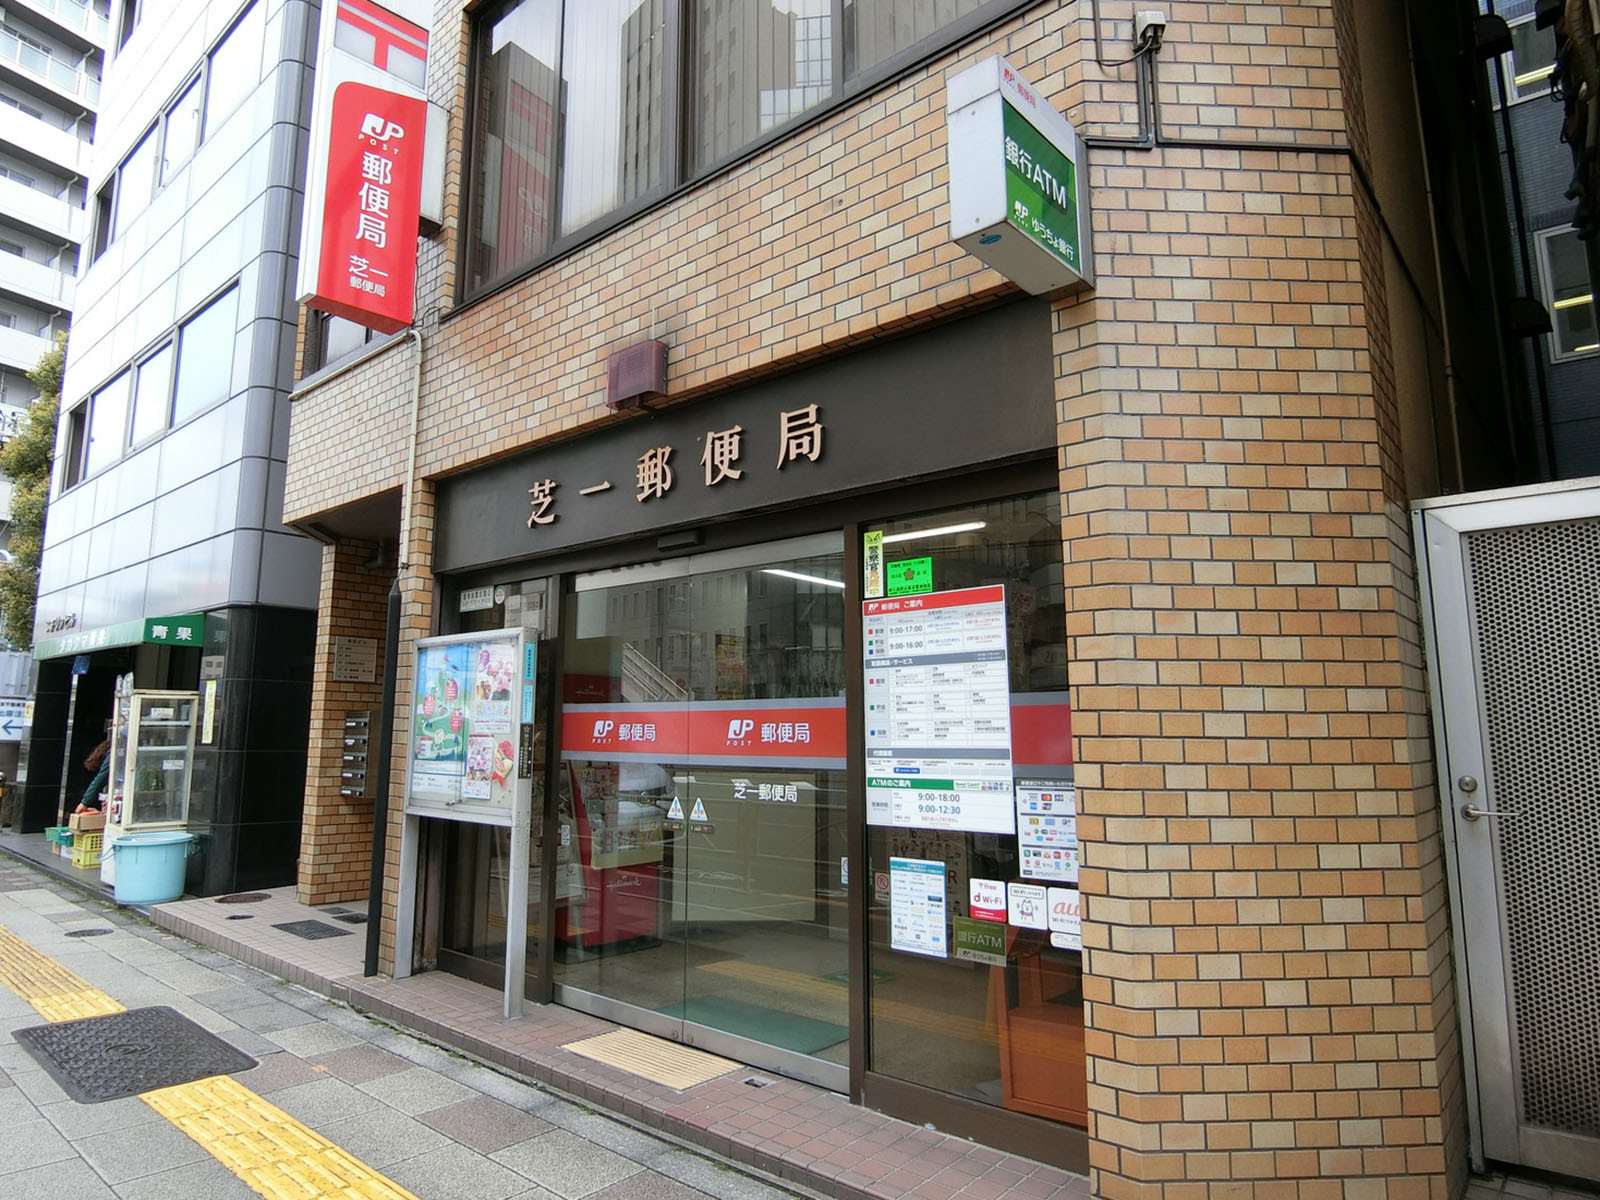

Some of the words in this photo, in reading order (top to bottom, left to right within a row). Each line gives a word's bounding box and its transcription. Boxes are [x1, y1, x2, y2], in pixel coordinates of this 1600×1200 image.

[358, 133, 400, 155] POST
[1005, 136, 1067, 209] 銀行ATM
[355, 151, 393, 249] 郵便局
[1031, 217, 1074, 261] ゆうちょ銀行
[348, 254, 390, 279] 芝一
[349, 275, 387, 298] 郵便局
[526, 403, 824, 529] 芝一郵便局
[151, 624, 193, 641] 青果
[889, 625, 923, 634] 9:00-17:00
[618, 723, 656, 742] 郵便局
[760, 722, 811, 743] 郵便局
[733, 782, 799, 803] 芝一郵便局
[918, 792, 961, 802] 9:00-18:00
[918, 804, 961, 814] 9:00-12:30
[982, 895, 1003, 906] Wi-Fi
[957, 931, 1002, 949] 銀行ATM
